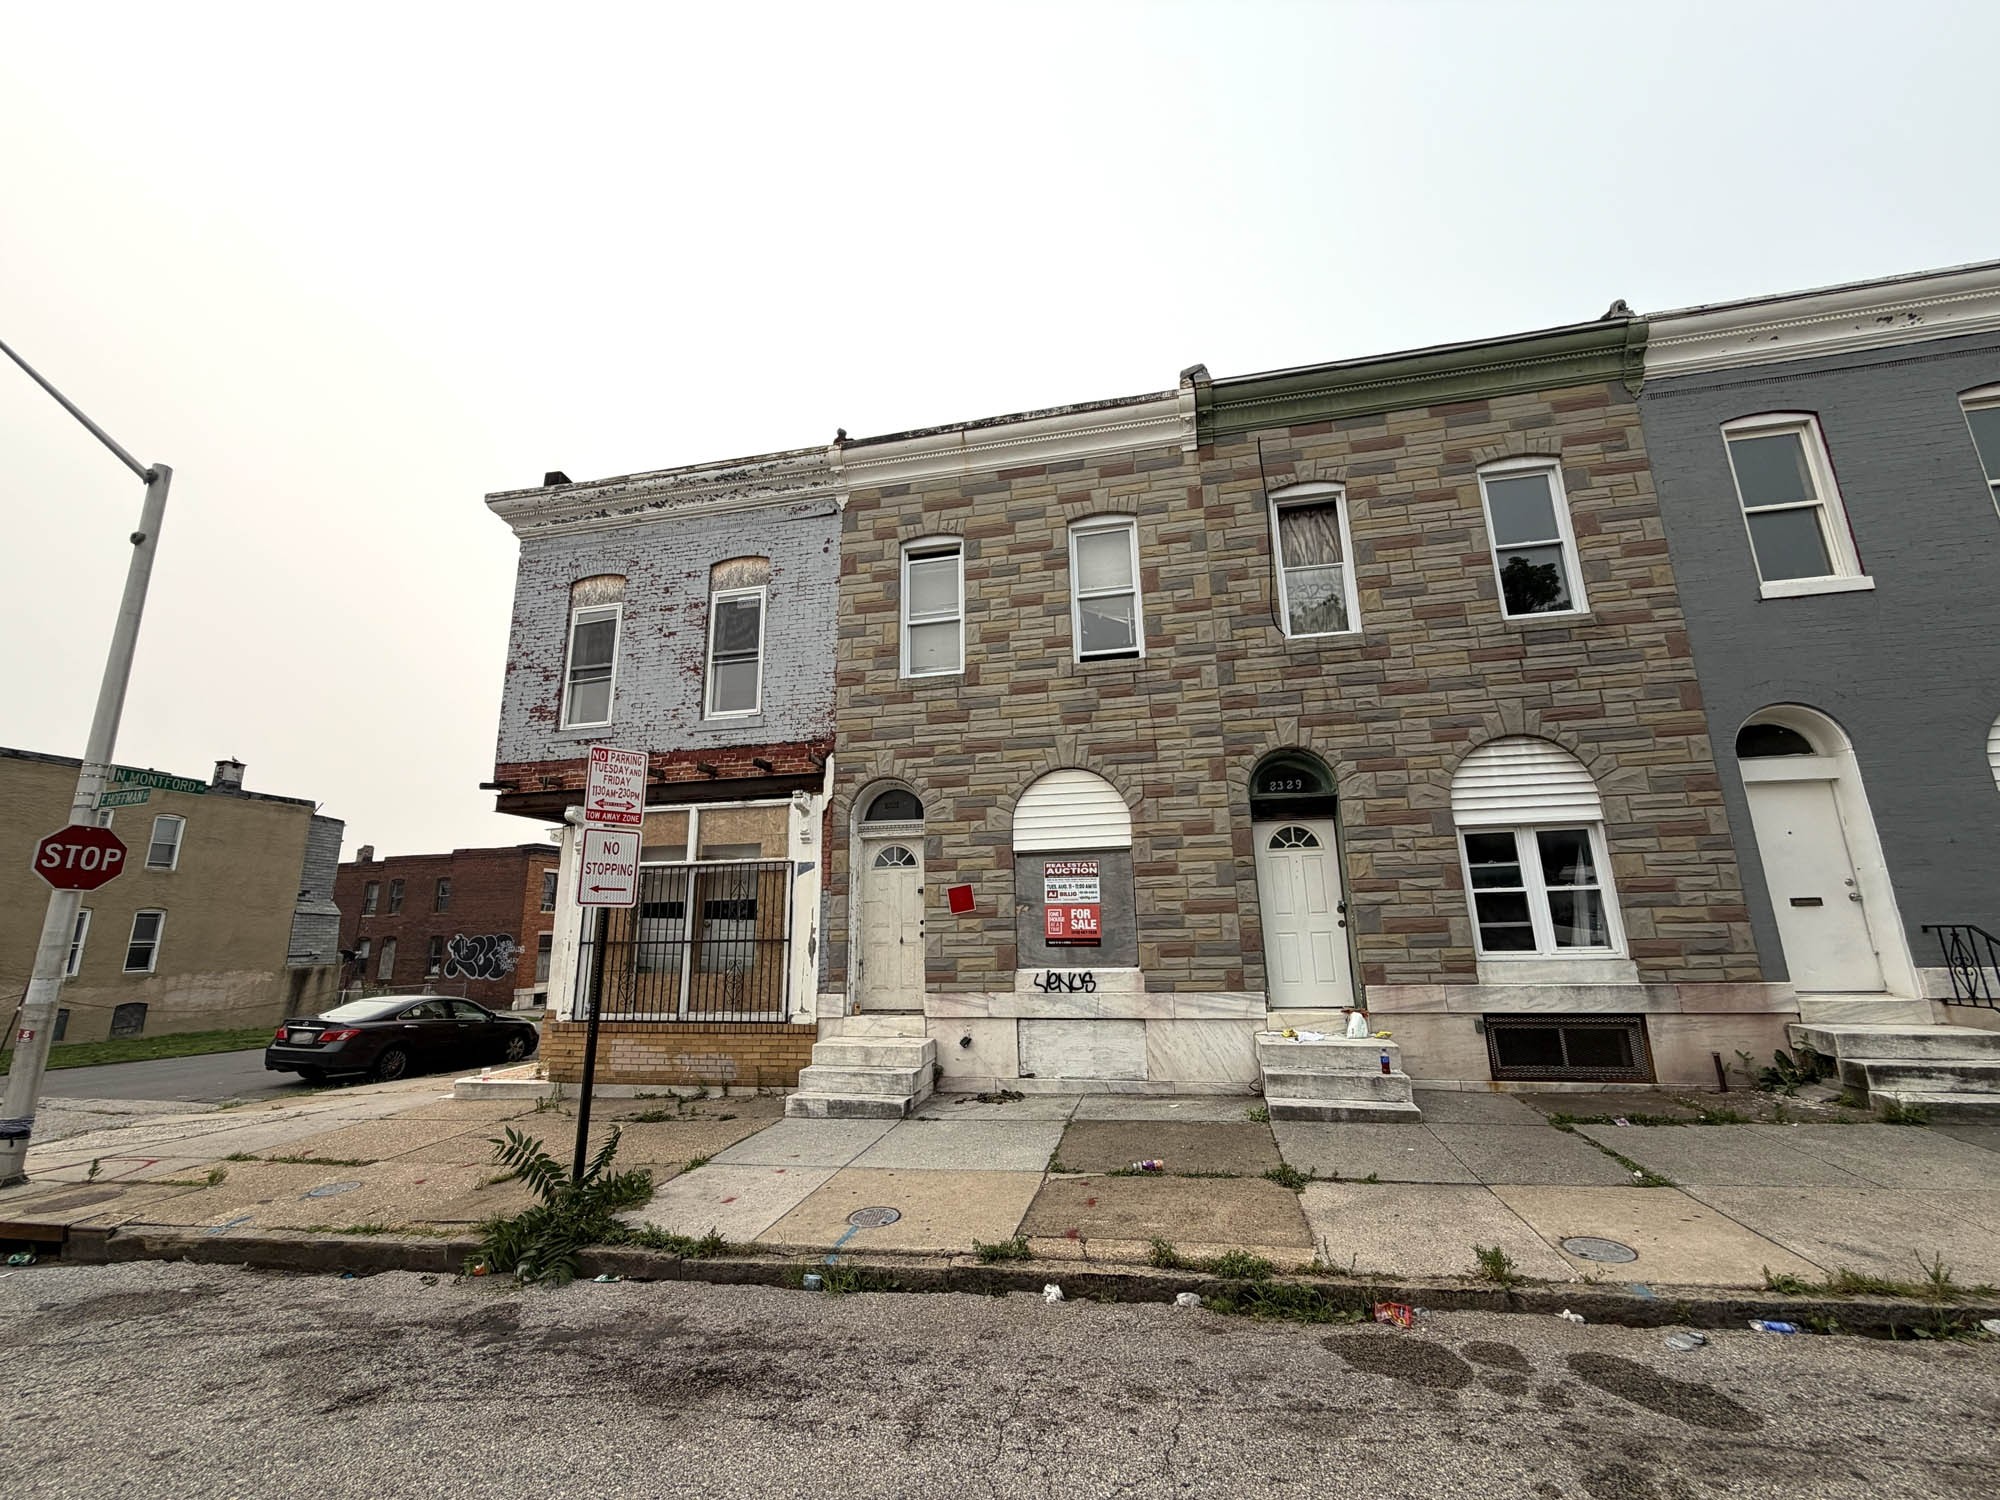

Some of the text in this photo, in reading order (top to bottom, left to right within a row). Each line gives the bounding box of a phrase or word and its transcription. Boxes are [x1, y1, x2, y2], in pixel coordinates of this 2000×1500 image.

[592, 750, 642, 767] NO PARKING
[594, 762, 642, 777] TUESDAY AND
[116, 769, 126, 782] N
[130, 772, 196, 793] MONTFORD
[603, 774, 631, 787] FRIDAY
[1269, 779, 1302, 791] 2329
[101, 794, 107, 806] E
[108, 791, 144, 805] HOFFMAN
[586, 810, 640, 823] TOW AWAY ZONE
[603, 841, 620, 855] NO
[41, 843, 122, 872] STOP
[585, 862, 633, 877] STOPPING
[1046, 867, 1097, 875] AUCTION
[1071, 909, 1091, 919] FOR
[1071, 919, 1097, 930] SALE
